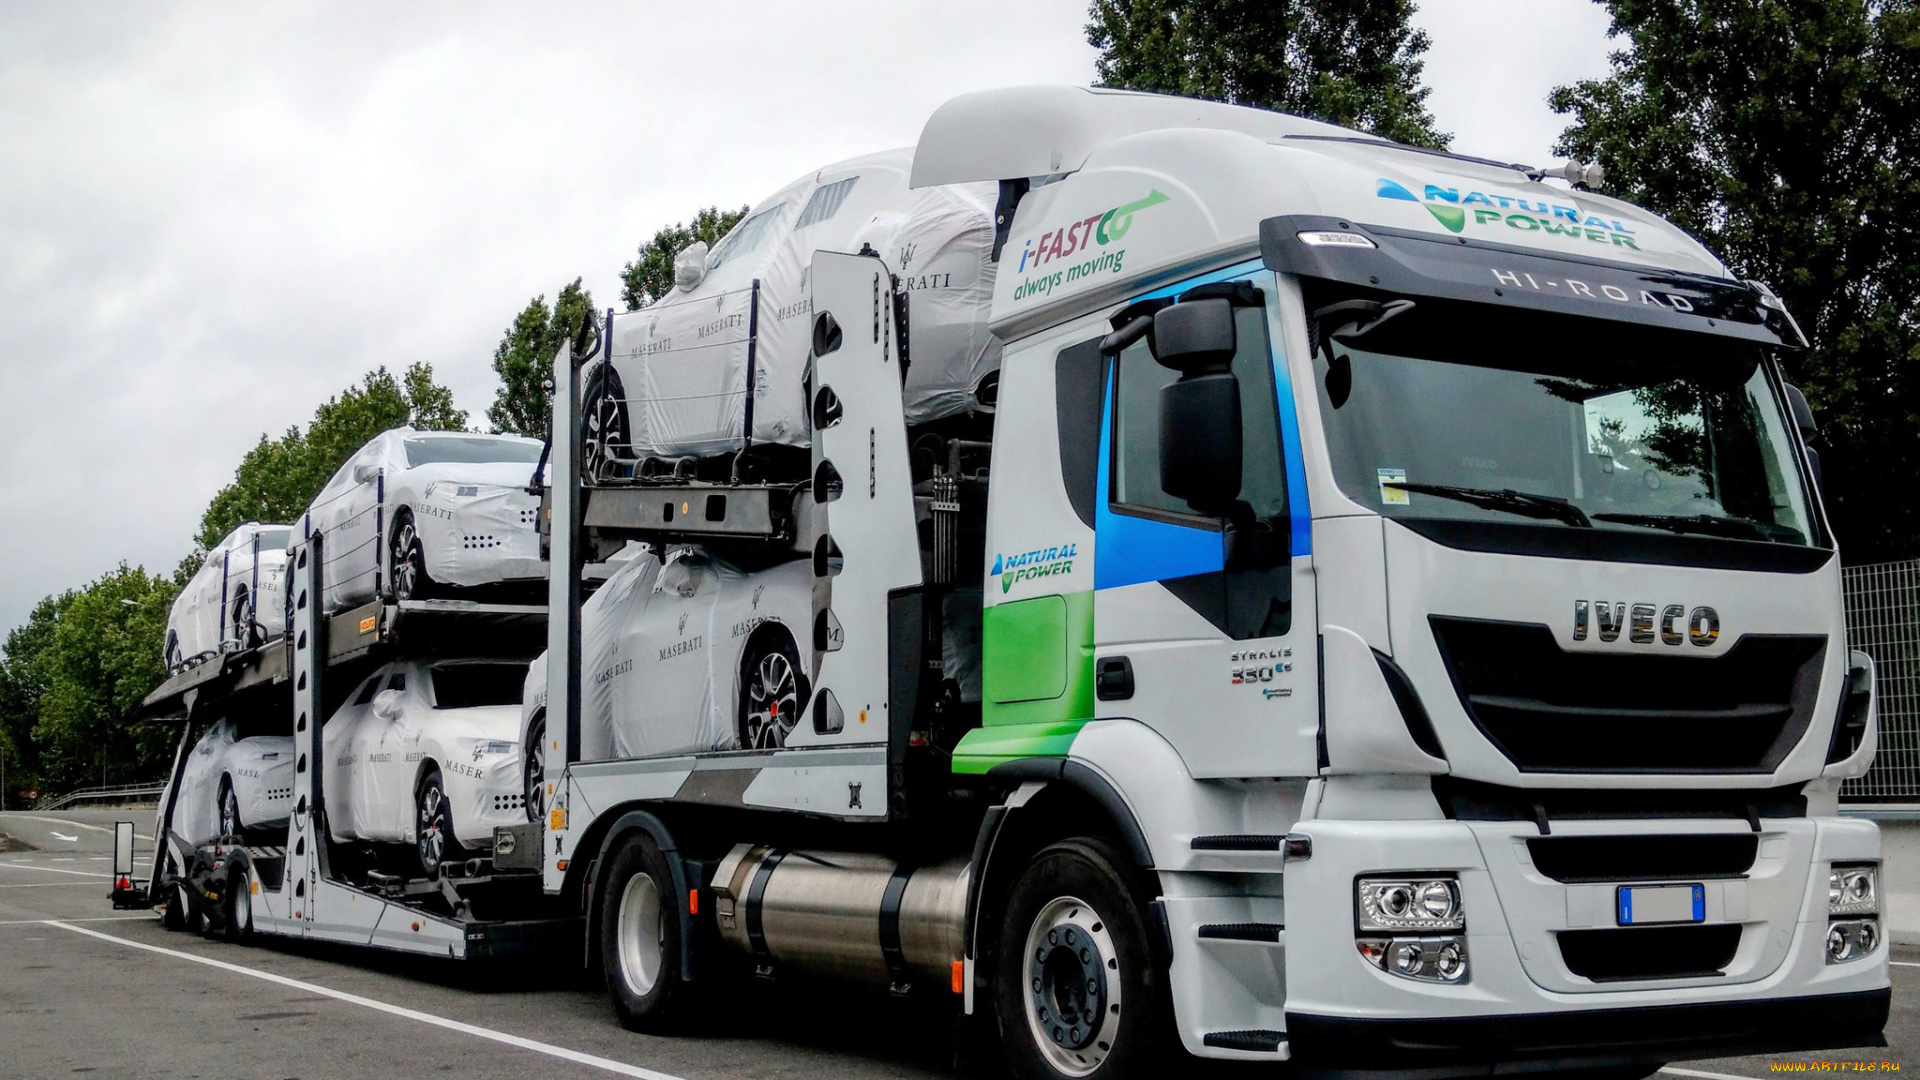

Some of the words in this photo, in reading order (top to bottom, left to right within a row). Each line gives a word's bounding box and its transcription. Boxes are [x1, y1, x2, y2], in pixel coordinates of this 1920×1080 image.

[1424, 184, 1637, 235] NATURAL
[1474, 208, 1642, 251] POWER
[1014, 271, 1063, 301] always
[1066, 249, 1126, 283] moving
[1490, 268, 1695, 313] HI-ROAD
[697, 313, 744, 340] MASERATI
[630, 337, 672, 360] MASERATI
[1005, 543, 1078, 570] NATURAL
[1015, 560, 1073, 583] POWER
[1572, 599, 1721, 648] IVECO
[658, 634, 703, 662] MASERATI
[1231, 647, 1292, 662] STRALIS
[444, 758, 486, 781] MASER
